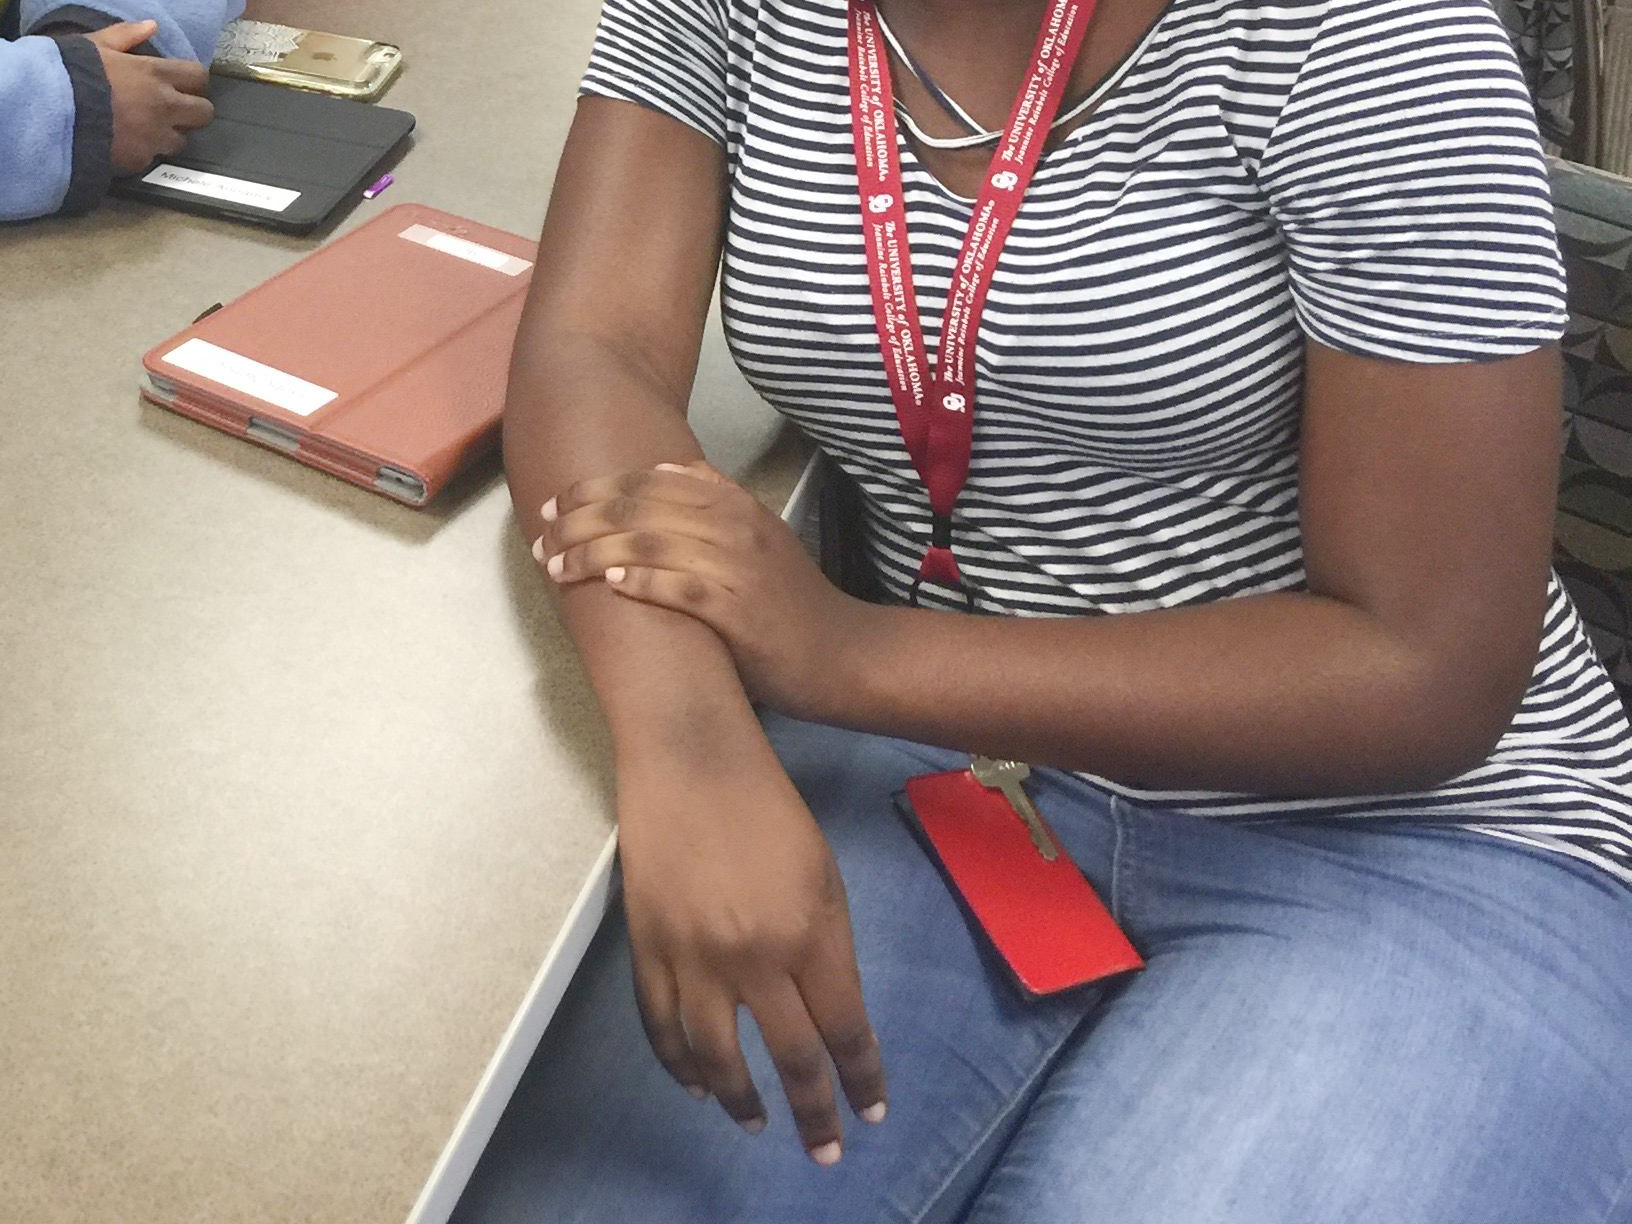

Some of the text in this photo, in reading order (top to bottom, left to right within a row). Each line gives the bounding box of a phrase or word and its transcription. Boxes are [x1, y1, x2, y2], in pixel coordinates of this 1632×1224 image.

[1043, 58, 1060, 88] College
[1057, 4, 1078, 47] Education
[864, 28, 882, 94] UNIVERSITY
[873, 109, 889, 176] OKLAHOMA
[1001, 144, 1015, 161] The
[1008, 74, 1042, 143] UNIVERSITY
[885, 220, 896, 238] The
[961, 206, 993, 274] OKLAHOMA
[887, 239, 907, 312] UNIVERSITY
[944, 290, 965, 364] UNIVERSITY
[900, 329, 924, 400] OKLAHOMA
[943, 365, 953, 383] The
